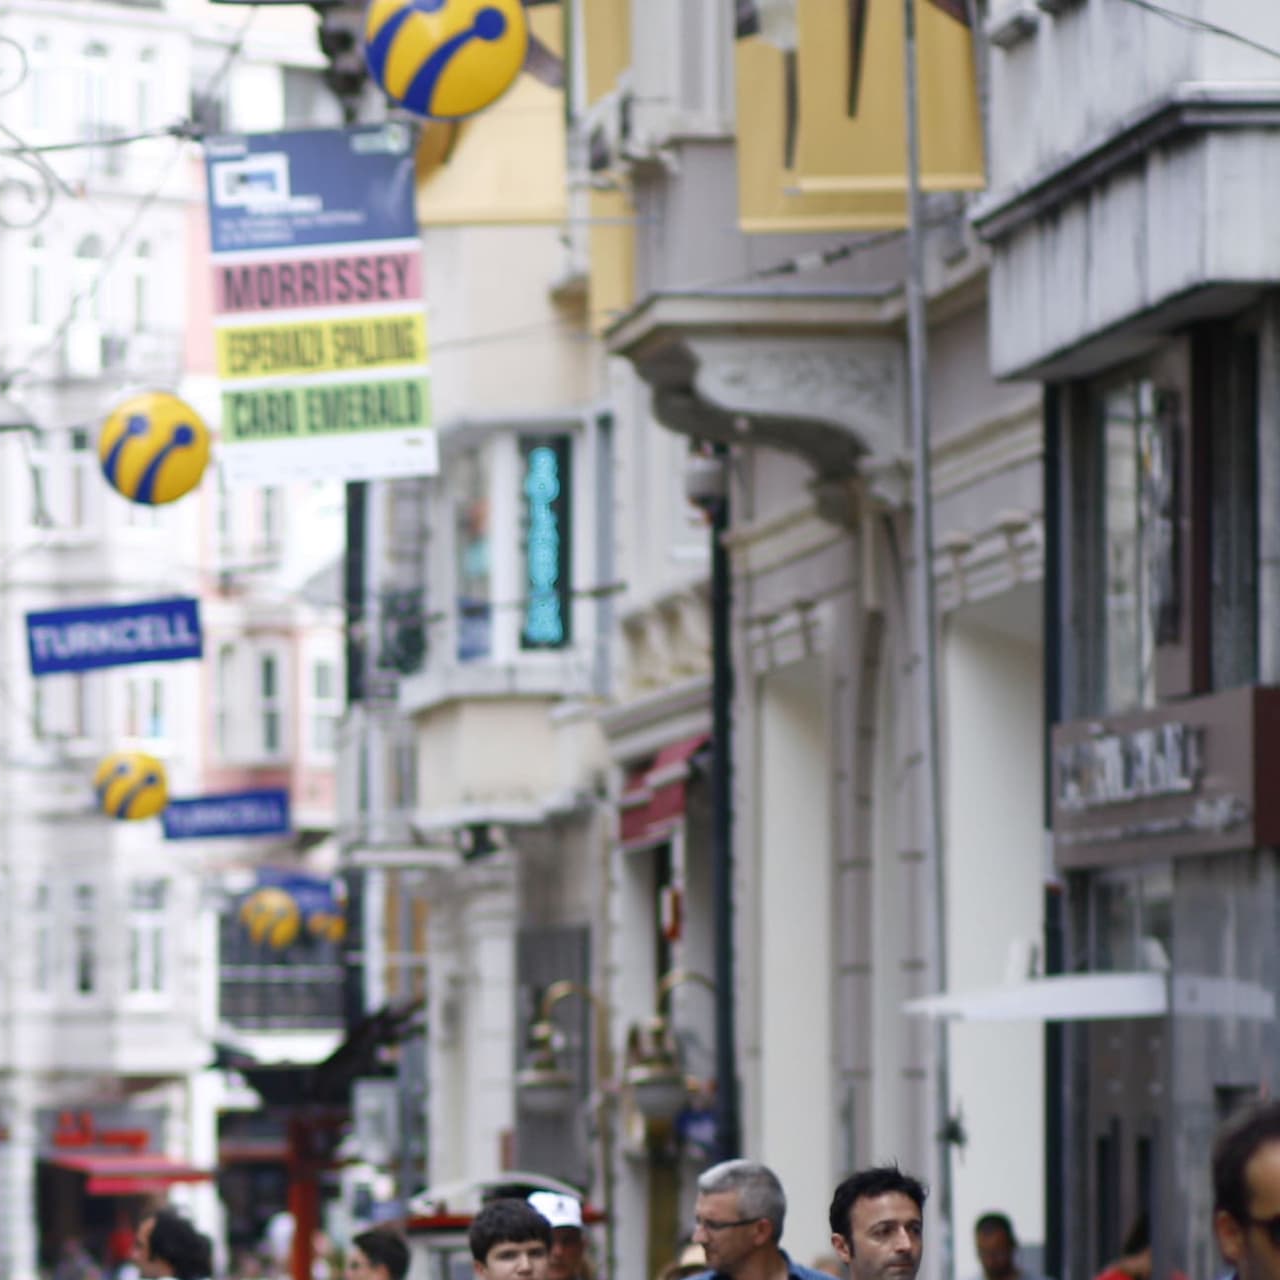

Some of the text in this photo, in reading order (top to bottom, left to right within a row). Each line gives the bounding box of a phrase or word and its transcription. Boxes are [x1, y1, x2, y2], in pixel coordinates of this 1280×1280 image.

[224, 255, 409, 309] MORRISSEY
[231, 381, 422, 437] CARO EMERALD
[31, 614, 197, 660] TURKCELL
